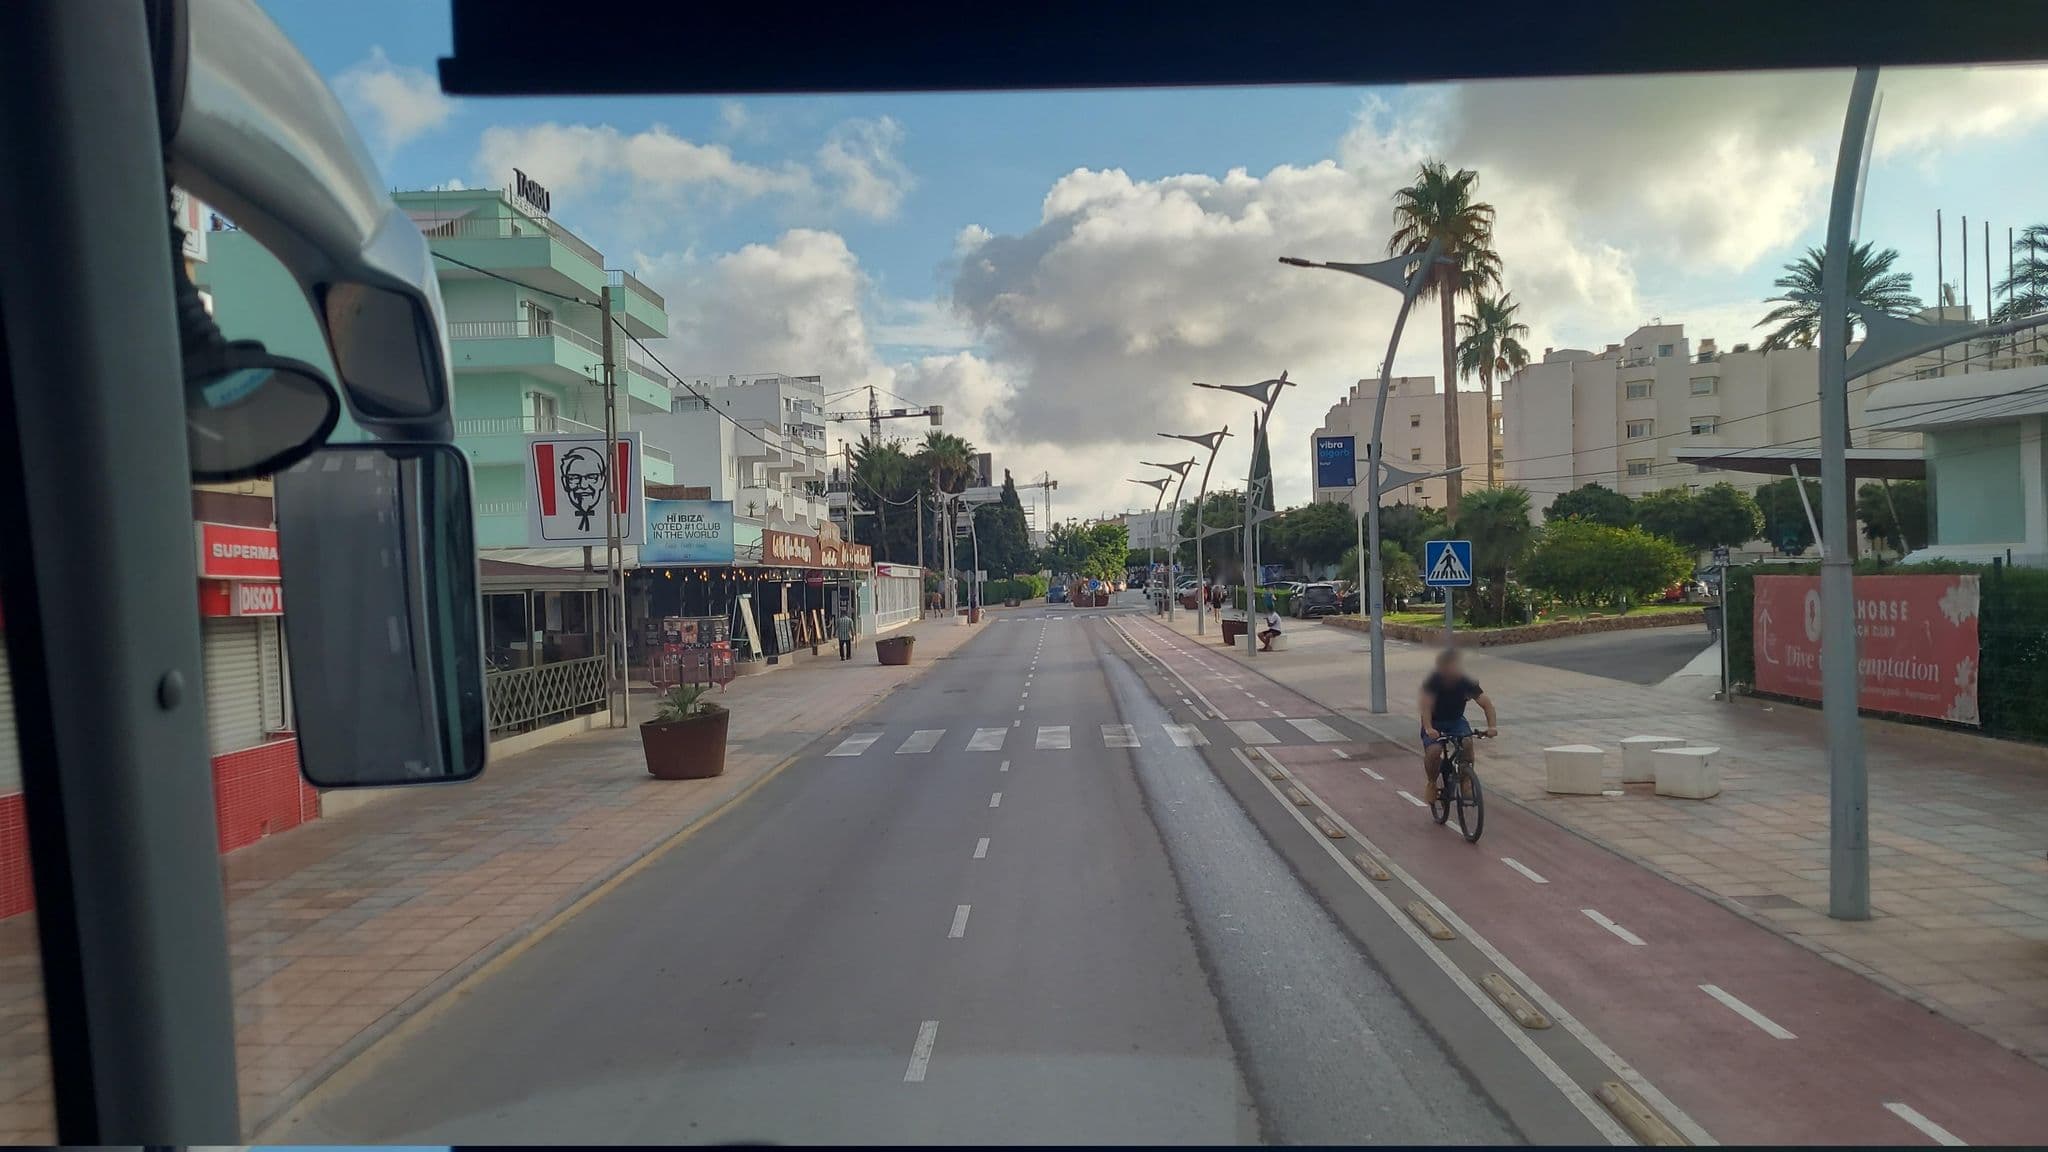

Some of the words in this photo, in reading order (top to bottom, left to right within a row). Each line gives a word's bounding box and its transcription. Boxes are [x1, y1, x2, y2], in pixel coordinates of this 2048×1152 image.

[651, 523, 682, 531] VOTED
[684, 523, 695, 531] #1
[695, 523, 721, 531] CLUB
[653, 531, 662, 539] IN
[664, 531, 683, 539] THE
[684, 531, 719, 539] WORLD
[213, 543, 279, 560] SUPERMA
[241, 586, 274, 611] DISCO
[1851, 599, 1908, 621] HORSE
[1785, 645, 1815, 669] Dive
[1857, 655, 1940, 682] emptation
